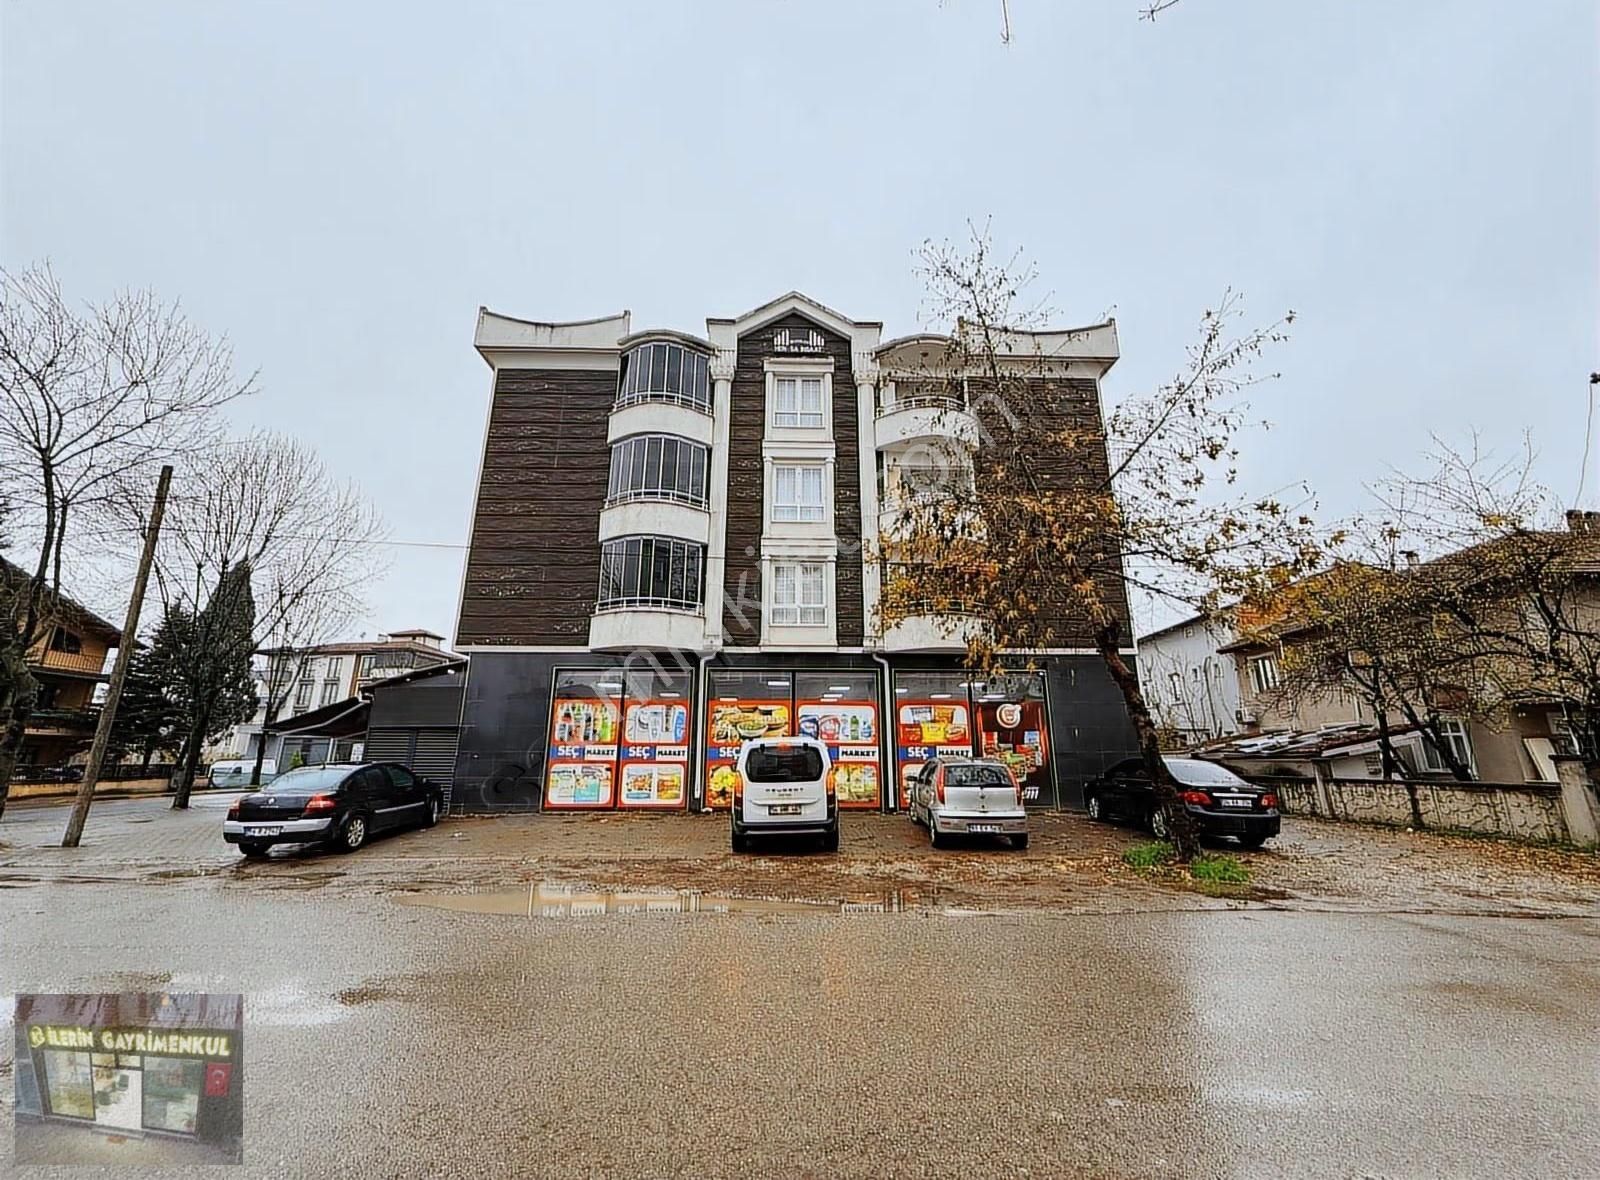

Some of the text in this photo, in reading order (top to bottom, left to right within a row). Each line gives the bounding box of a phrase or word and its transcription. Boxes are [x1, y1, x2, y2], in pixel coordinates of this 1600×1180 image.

[557, 745, 580, 758] SEÇ
[628, 745, 686, 759] SEÇ MARKET
[719, 746, 741, 760] SEÇ
[841, 750, 876, 758] MARKET
[907, 745, 970, 760] SEÇ MARKET
